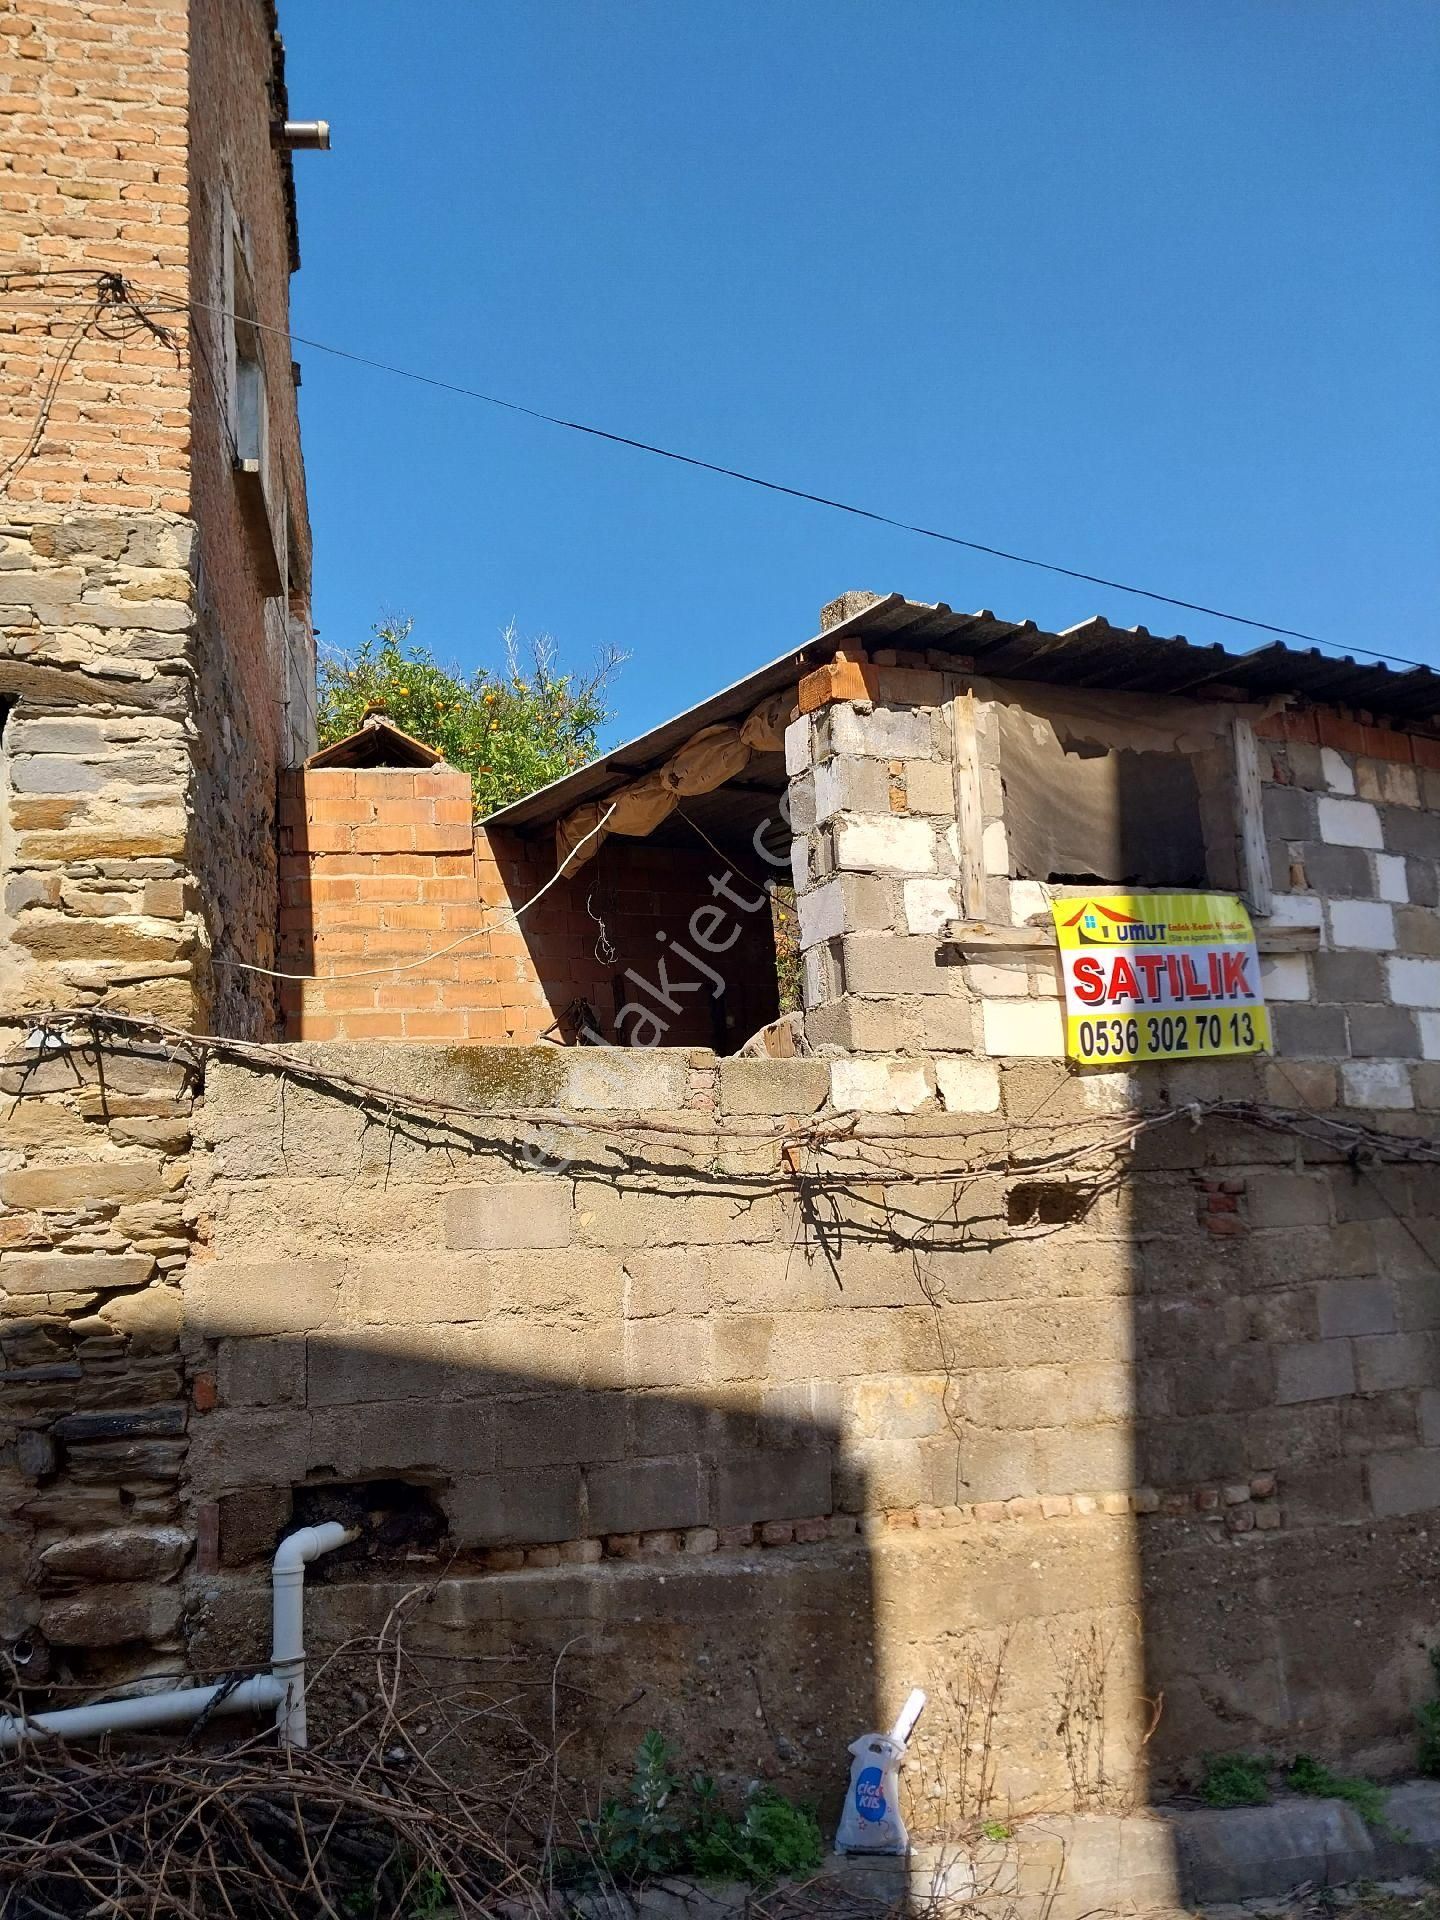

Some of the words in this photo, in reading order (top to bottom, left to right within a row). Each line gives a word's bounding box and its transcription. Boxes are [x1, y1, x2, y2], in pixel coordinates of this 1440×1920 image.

[1117, 924, 1167, 941] UMUT
[1073, 952, 1255, 1006] SATILIK
[1080, 1018, 1139, 1057] 0536
[1147, 1016, 1188, 1052] 302
[1195, 1014, 1221, 1049] 70
[1230, 1012, 1255, 1047] 13
